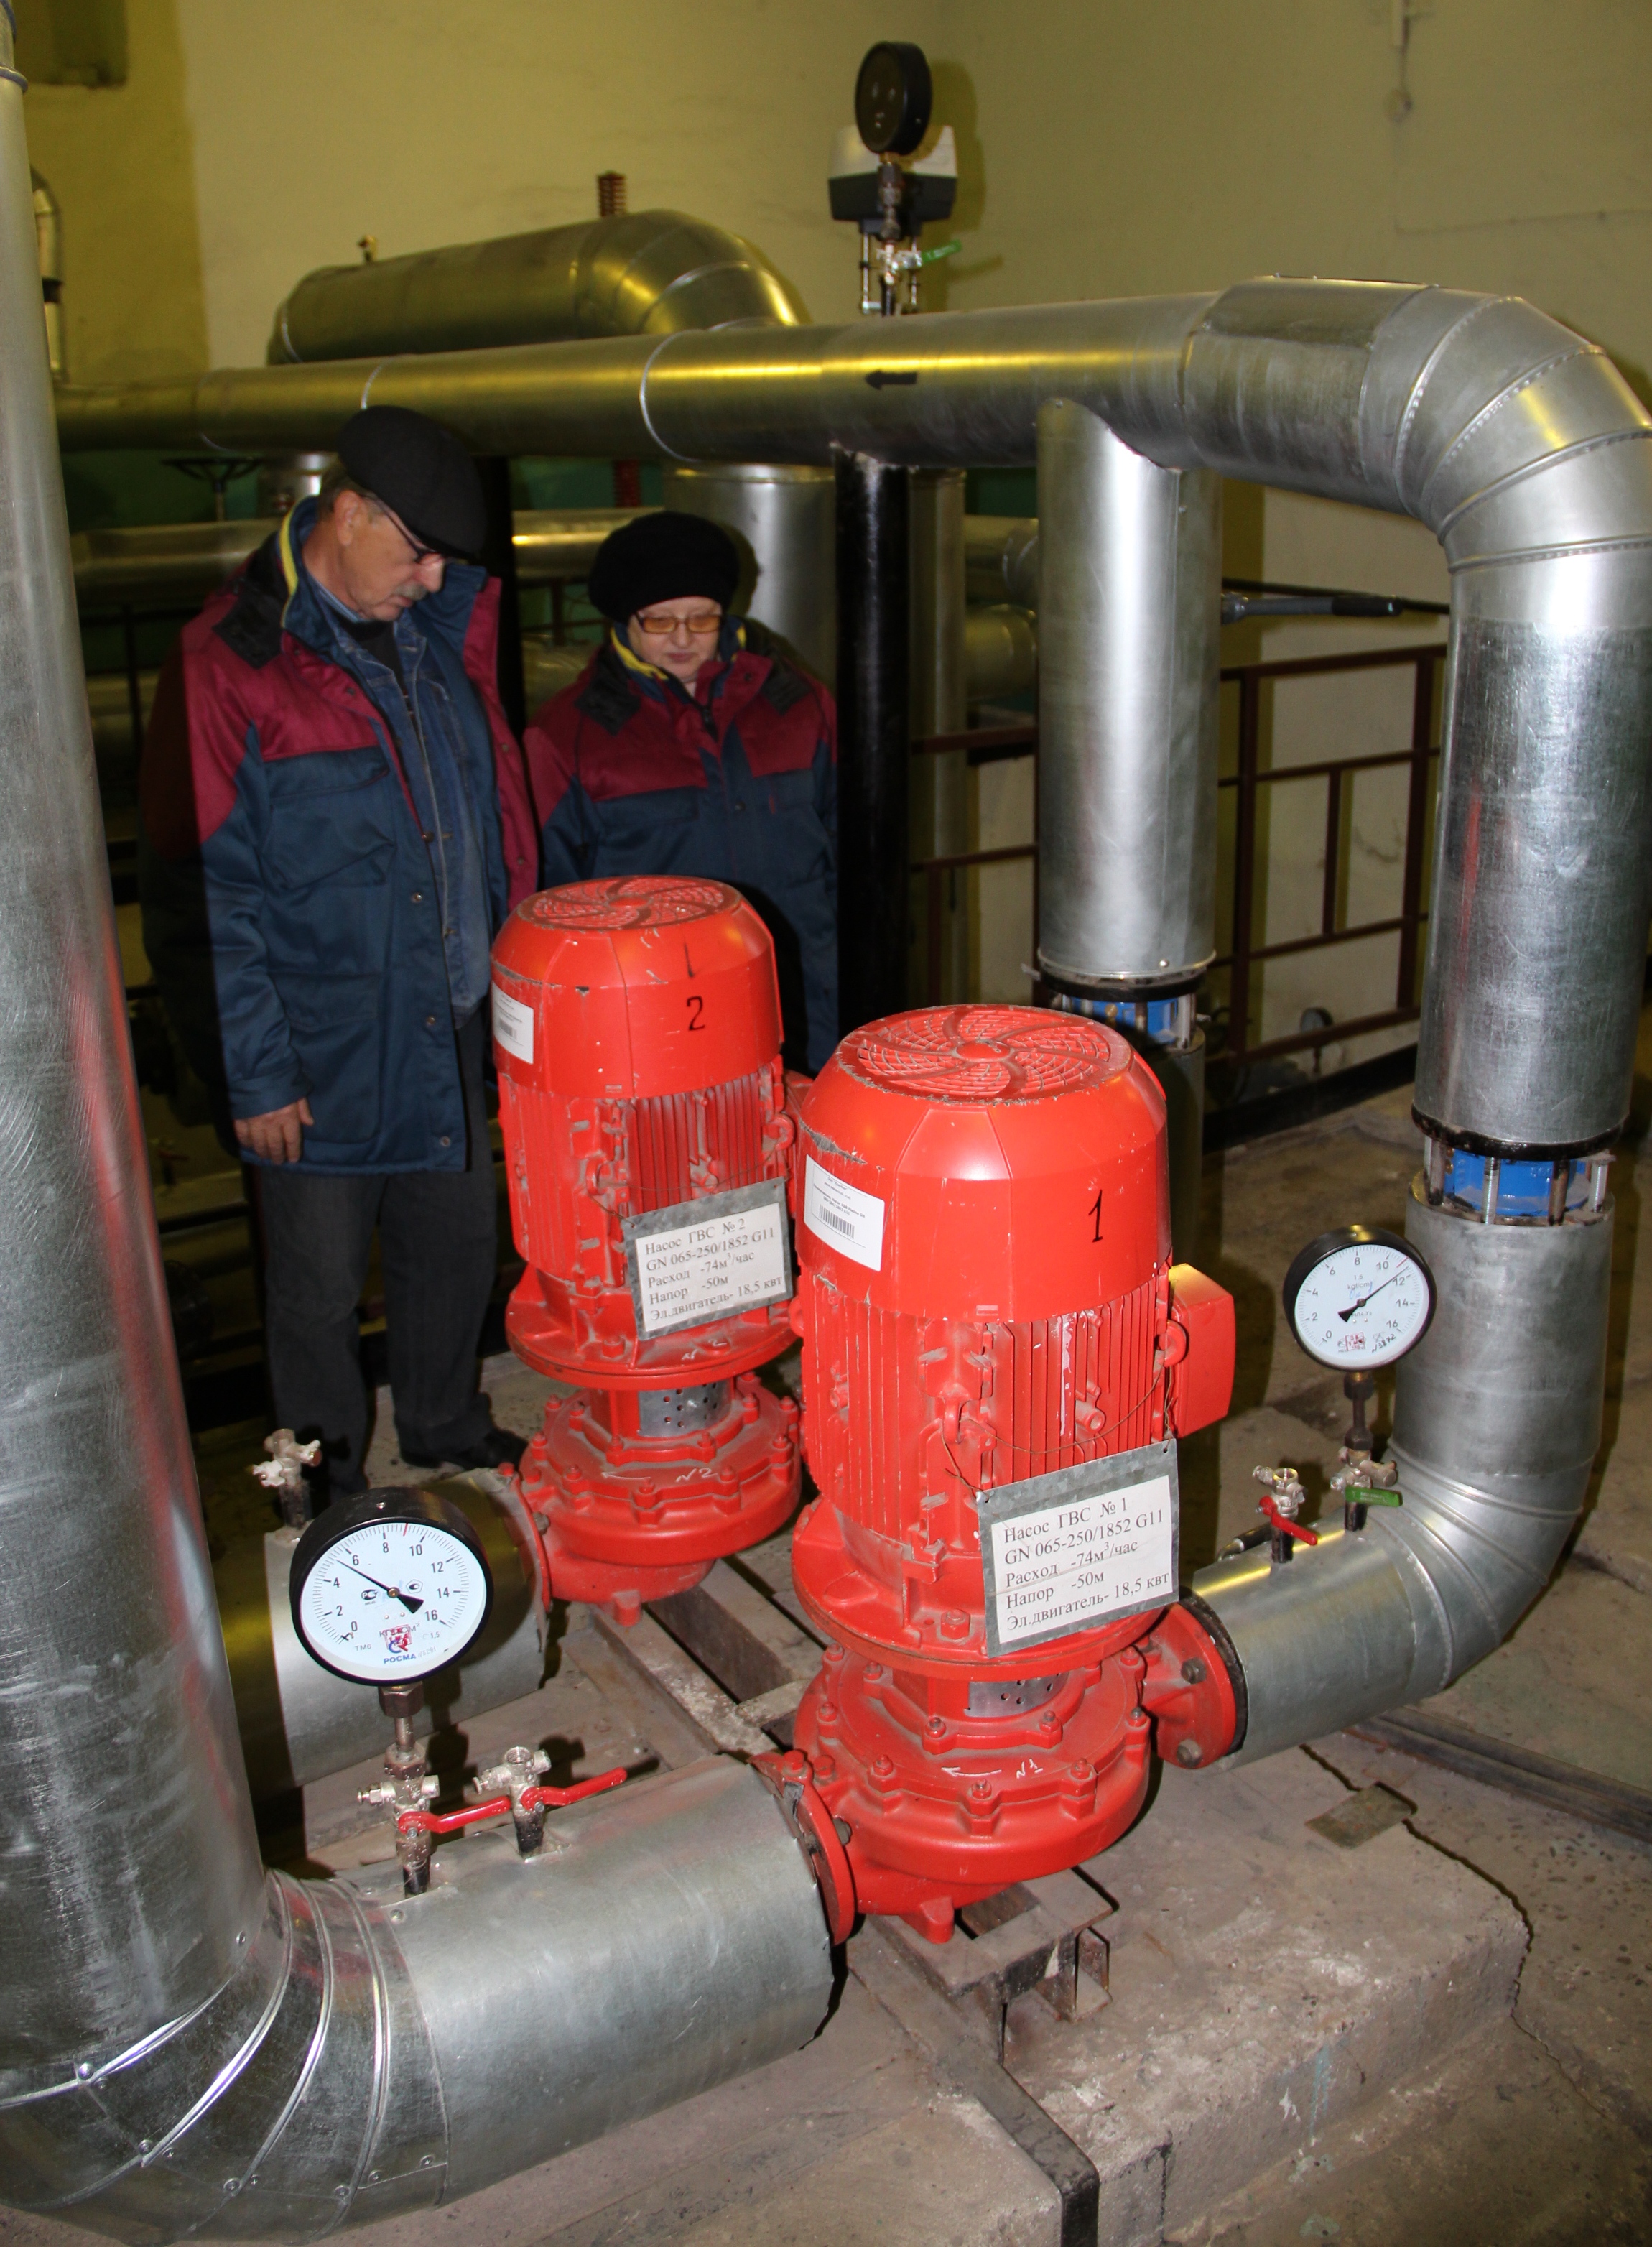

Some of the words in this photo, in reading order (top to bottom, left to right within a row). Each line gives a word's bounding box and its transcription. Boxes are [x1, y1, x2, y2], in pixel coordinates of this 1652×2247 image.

[687, 996, 705, 1031] 2
[1088, 1189, 1103, 1243] 1
[645, 1238, 682, 1255] Насос
[688, 1226, 715, 1243] ГВС
[722, 1221, 735, 1235] №
[738, 1218, 746, 1230] 2
[646, 1256, 667, 1271] GN
[671, 1234, 748, 1265] 065-250/1852
[751, 1227, 774, 1242] G11
[1354, 1257, 1360, 1266] 8
[1376, 1261, 1389, 1270] 10
[648, 1269, 690, 1288] Расход
[1393, 1277, 1405, 1286] 12
[738, 1280, 760, 1297] 18,5
[764, 1276, 782, 1289] квт
[649, 1287, 688, 1305] Напор
[1396, 1298, 1409, 1307] 14
[1312, 1312, 1318, 1321] 2
[1386, 1319, 1398, 1328] 16
[1326, 1330, 1332, 1339] 0
[699, 1467, 718, 1478] 2
[1003, 1520, 1049, 1544] Насос
[1058, 1507, 1091, 1529] ГВС
[1100, 1501, 1116, 1518] №
[1121, 1497, 1128, 1511] 1
[1004, 1545, 1030, 1565] GN
[1035, 1519, 1131, 1557] 065-250/1852
[1136, 1509, 1163, 1528] G11
[382, 1542, 389, 1553] 8
[409, 1544, 423, 1557] 10
[352, 1555, 359, 1566] 6
[431, 1562, 444, 1573] 12
[1006, 1563, 1058, 1588] Расход
[333, 1577, 340, 1588] 4
[1114, 1578, 1142, 1599] 18,5
[1146, 1572, 1169, 1588] квт
[437, 1587, 450, 1599] 14
[1006, 1586, 1054, 1609] Напор
[335, 1605, 343, 1616] 2
[425, 1609, 438, 1621] 16
[351, 1621, 358, 1632] 0
[384, 1653, 416, 1664] РОСМА
